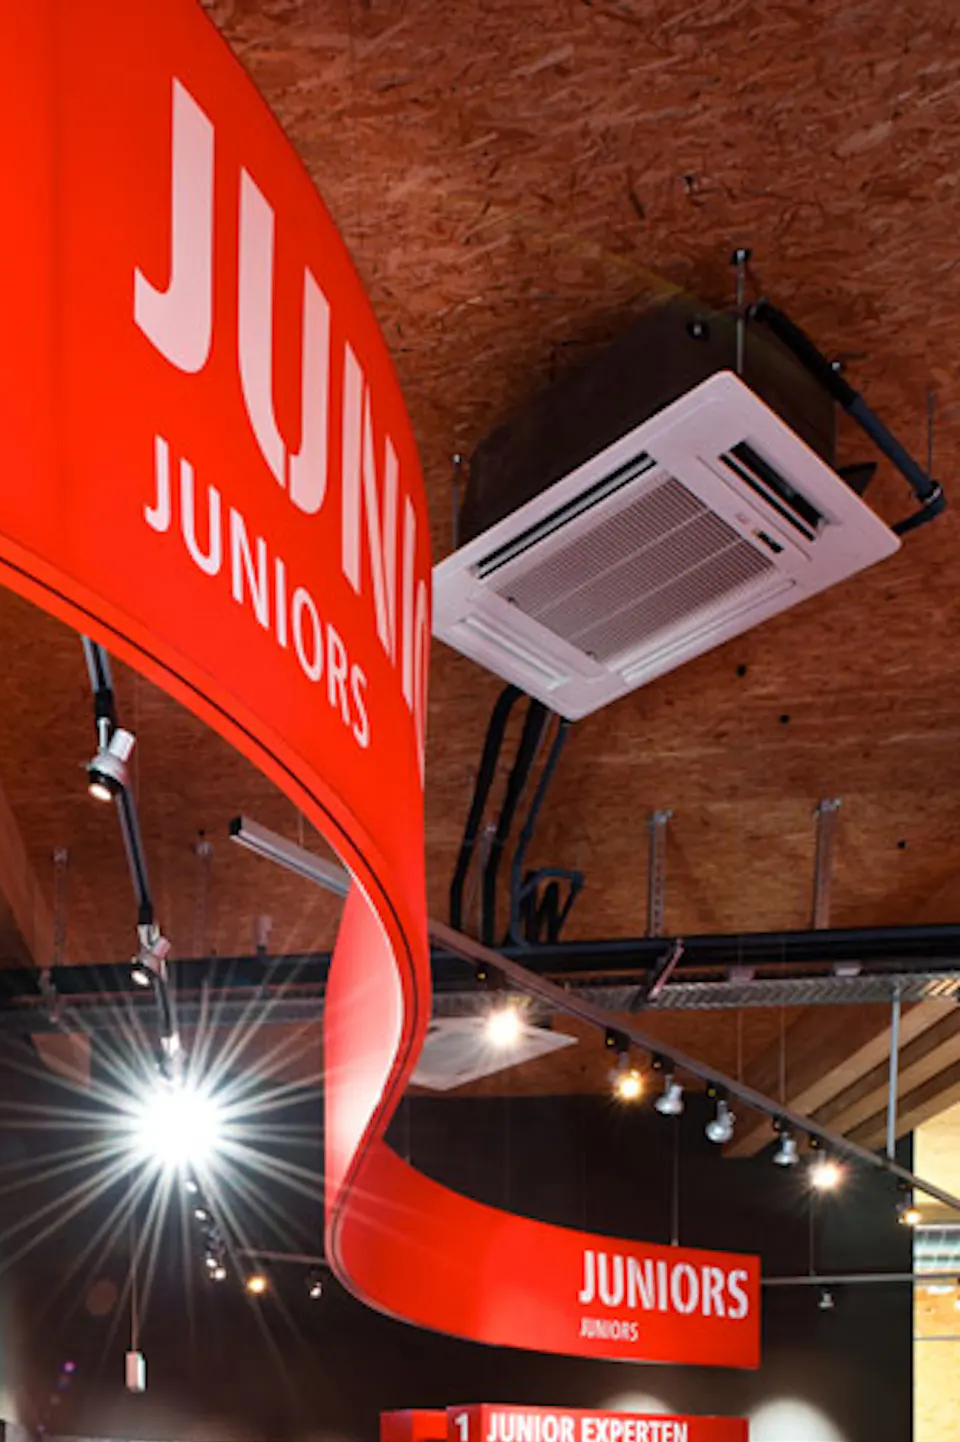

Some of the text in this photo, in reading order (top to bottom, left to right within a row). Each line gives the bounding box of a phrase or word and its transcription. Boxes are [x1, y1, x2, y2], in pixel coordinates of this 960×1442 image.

[144, 434, 371, 749] JUNIORS
[579, 1250, 748, 1319] JUNIORS
[580, 1318, 639, 1341] JUNIORS
[454, 1411, 469, 1442] 1
